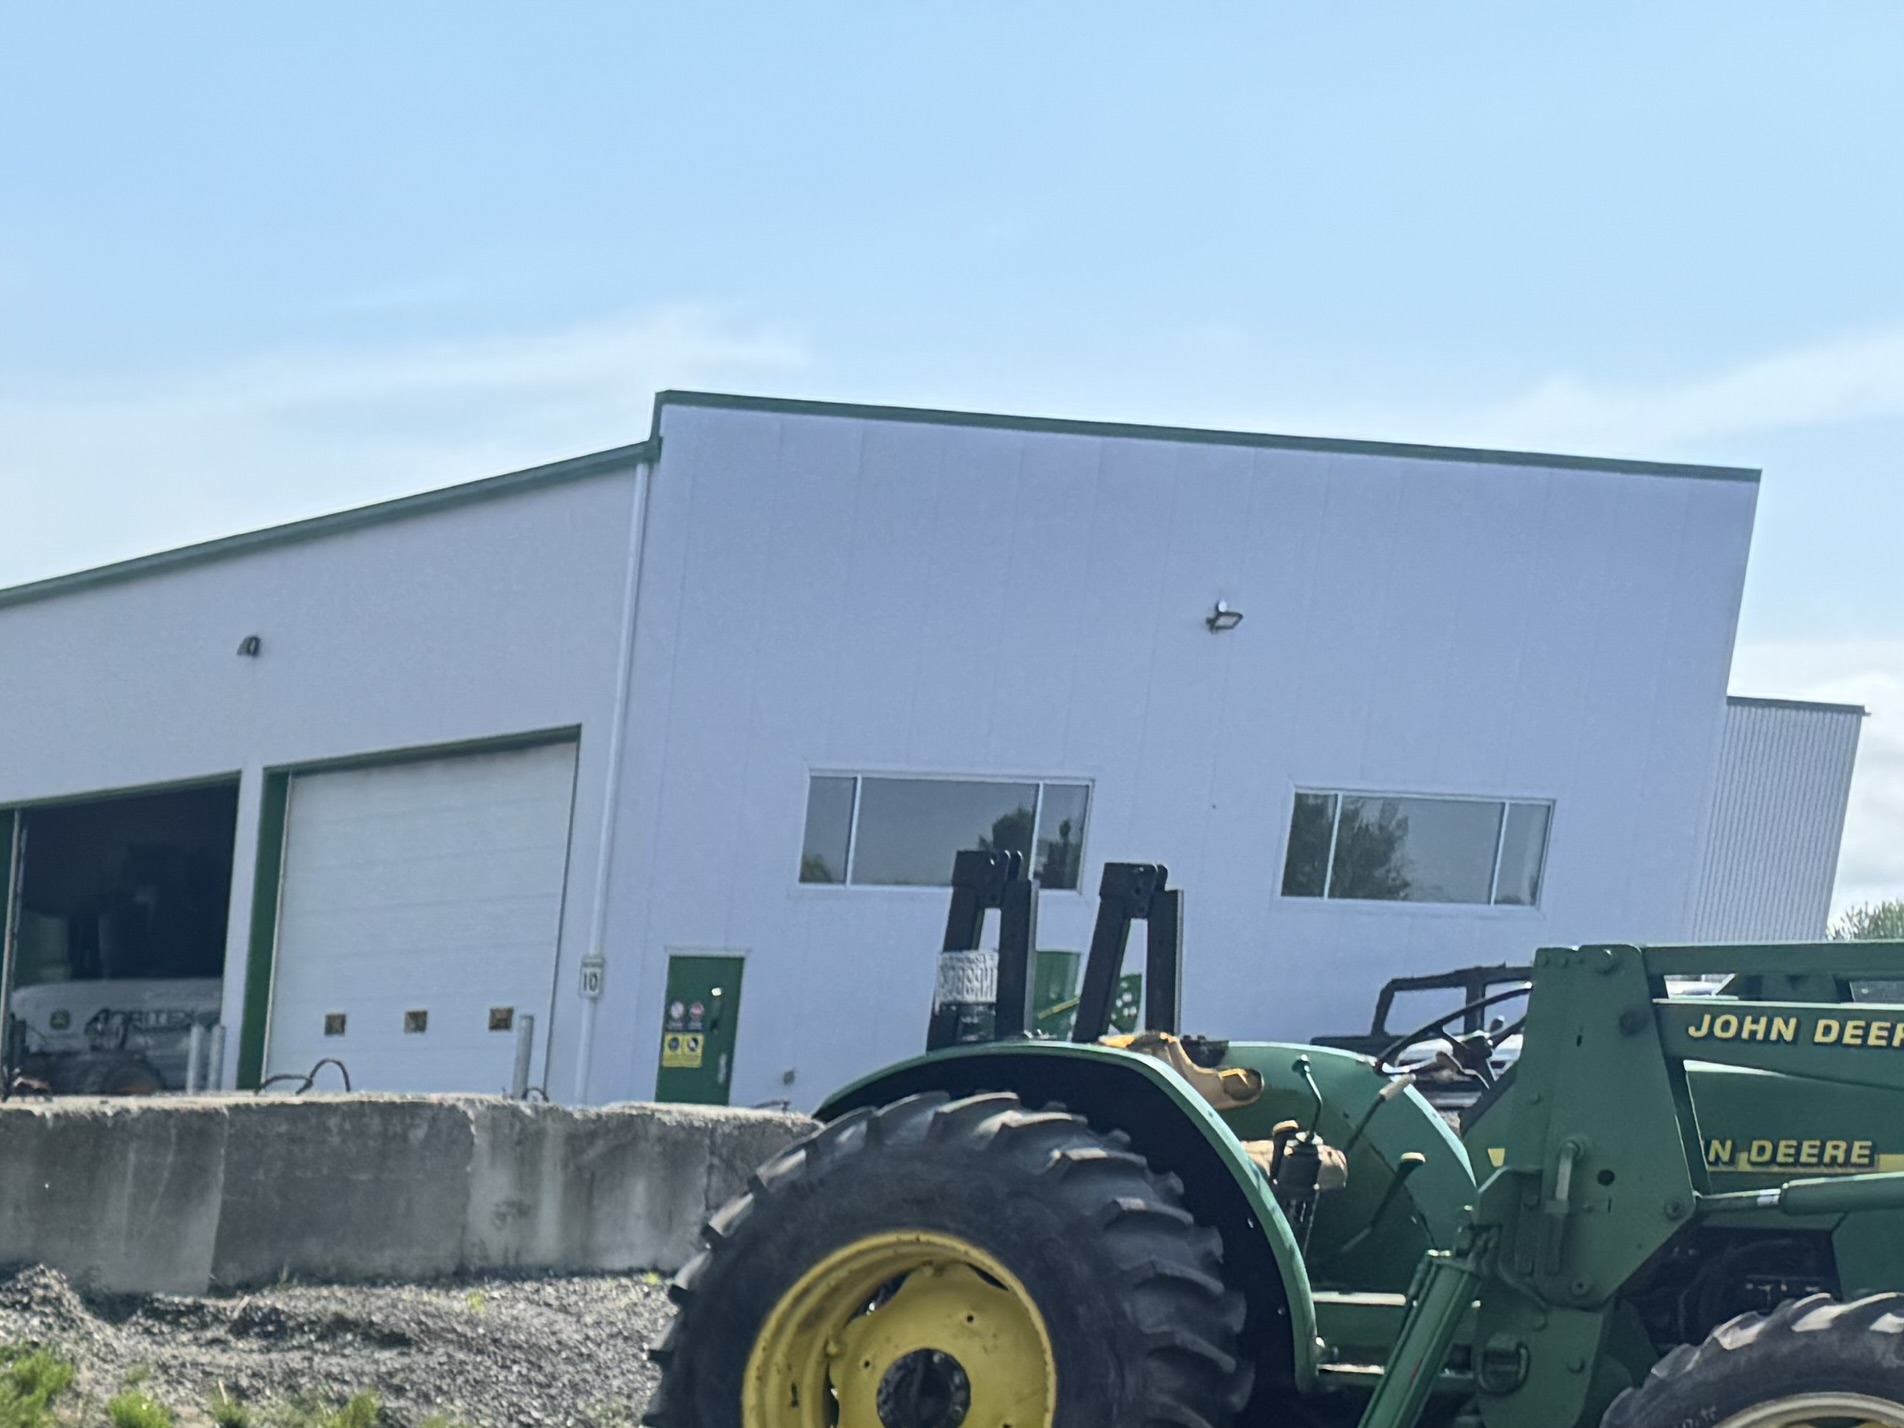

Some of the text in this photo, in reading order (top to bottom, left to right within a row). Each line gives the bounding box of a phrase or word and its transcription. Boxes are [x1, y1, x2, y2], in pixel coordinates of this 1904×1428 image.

[583, 972, 598, 992] 10
[1688, 1013, 1798, 1043] JOHN
[1749, 1139, 1874, 1165] DEERE
